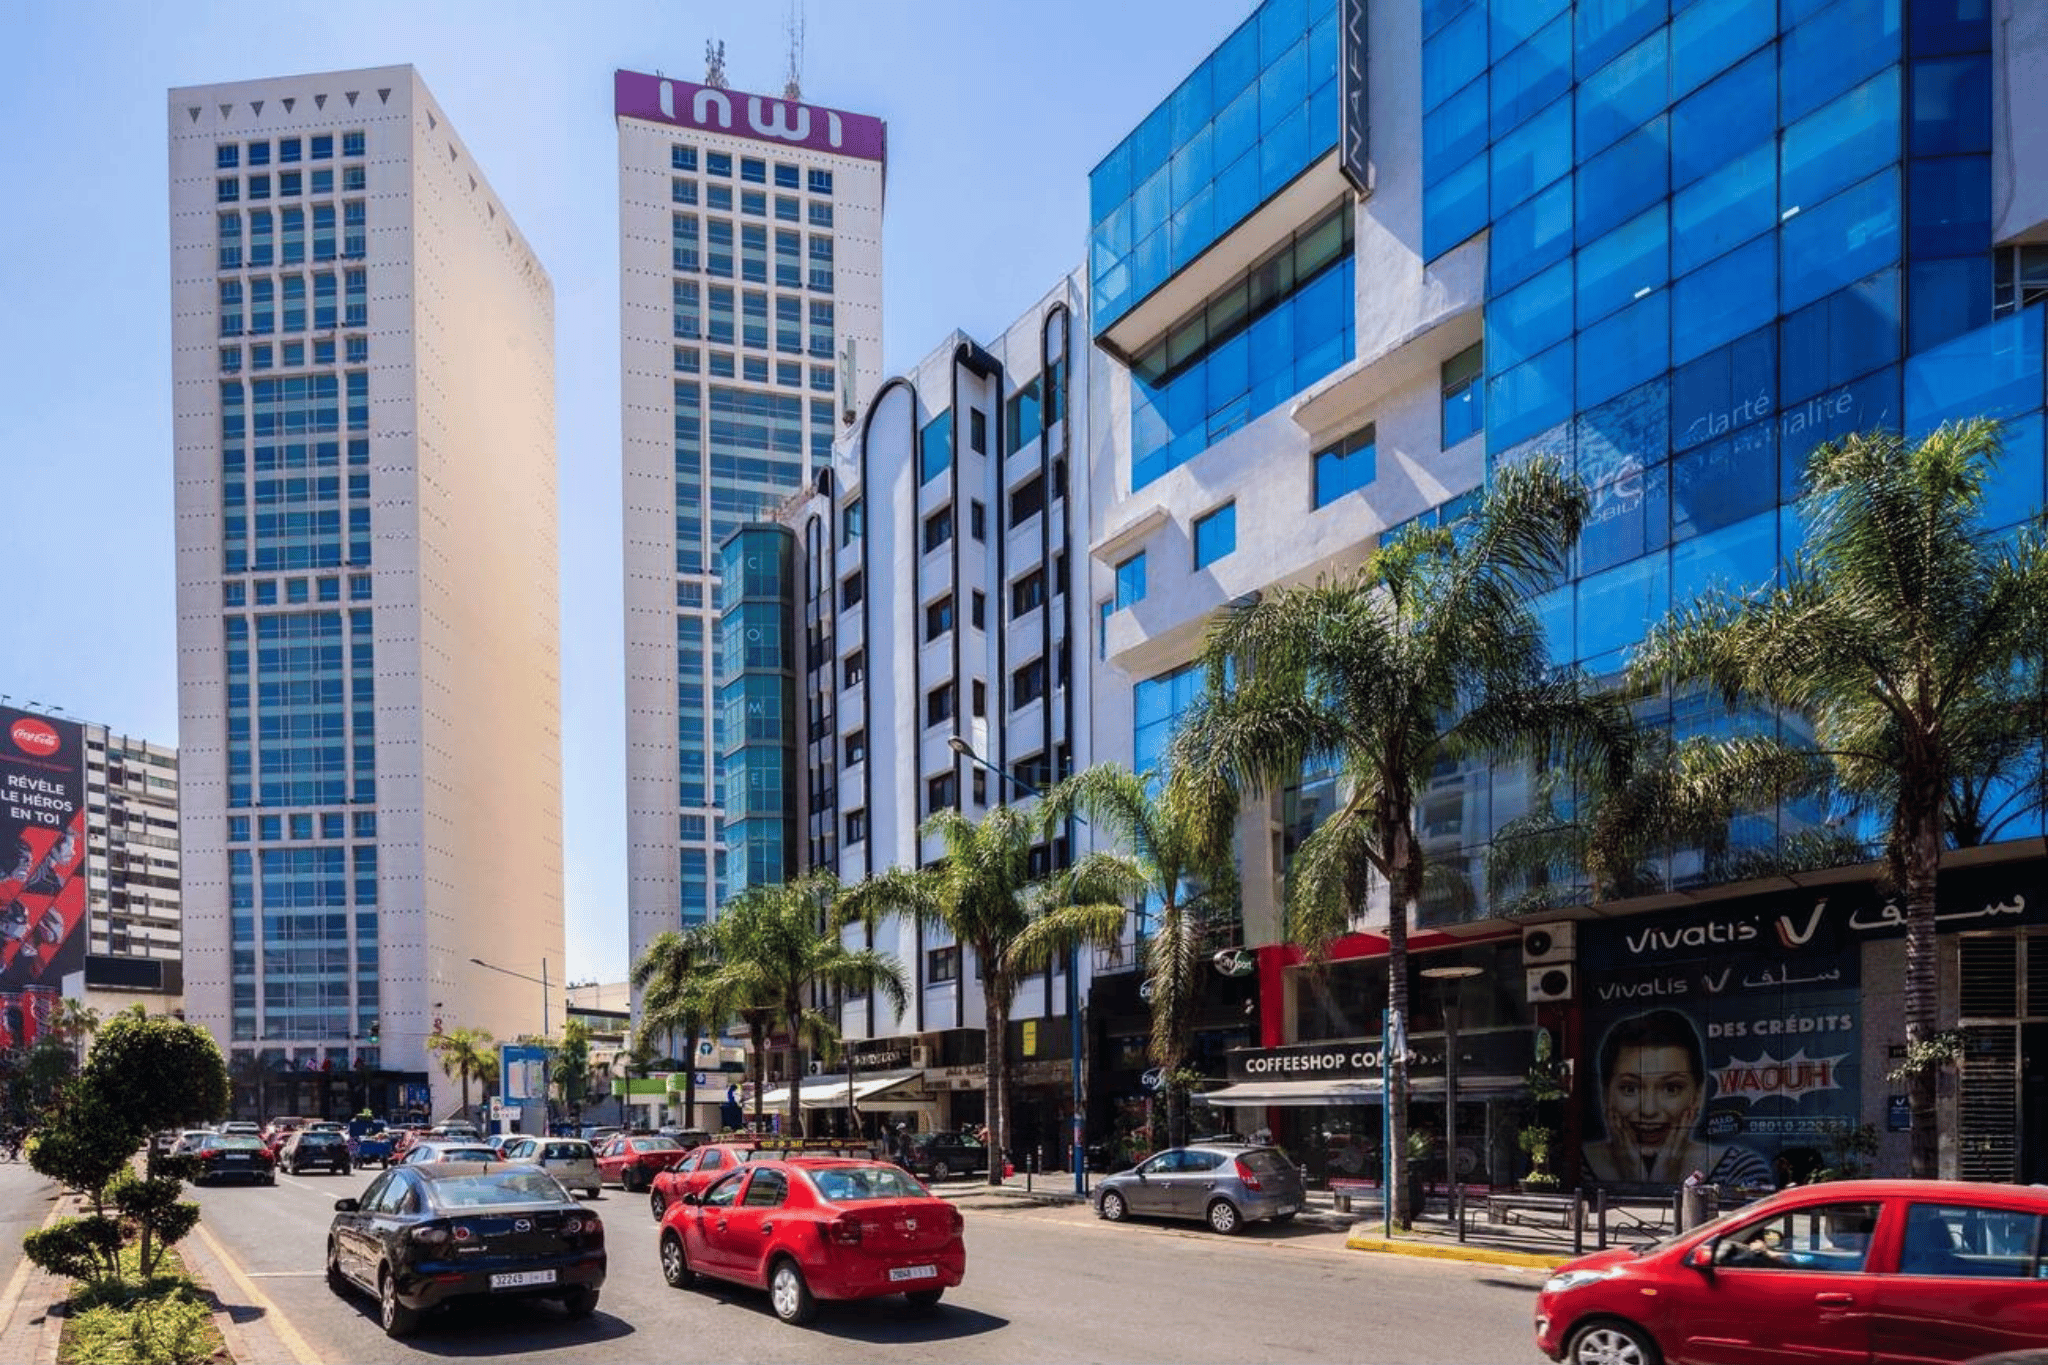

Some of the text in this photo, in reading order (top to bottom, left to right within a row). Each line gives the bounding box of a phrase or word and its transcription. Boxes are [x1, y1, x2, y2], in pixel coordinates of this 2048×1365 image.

[659, 80, 842, 148] inwi
[0, 789, 73, 812] LE HÉROS
[11, 807, 60, 825] EN TOI
[1709, 1014, 1853, 1038] DES CRÉDITS
[1245, 1054, 1346, 1073] COFFEESHOP
[1719, 1060, 1831, 1093] WAOUH
